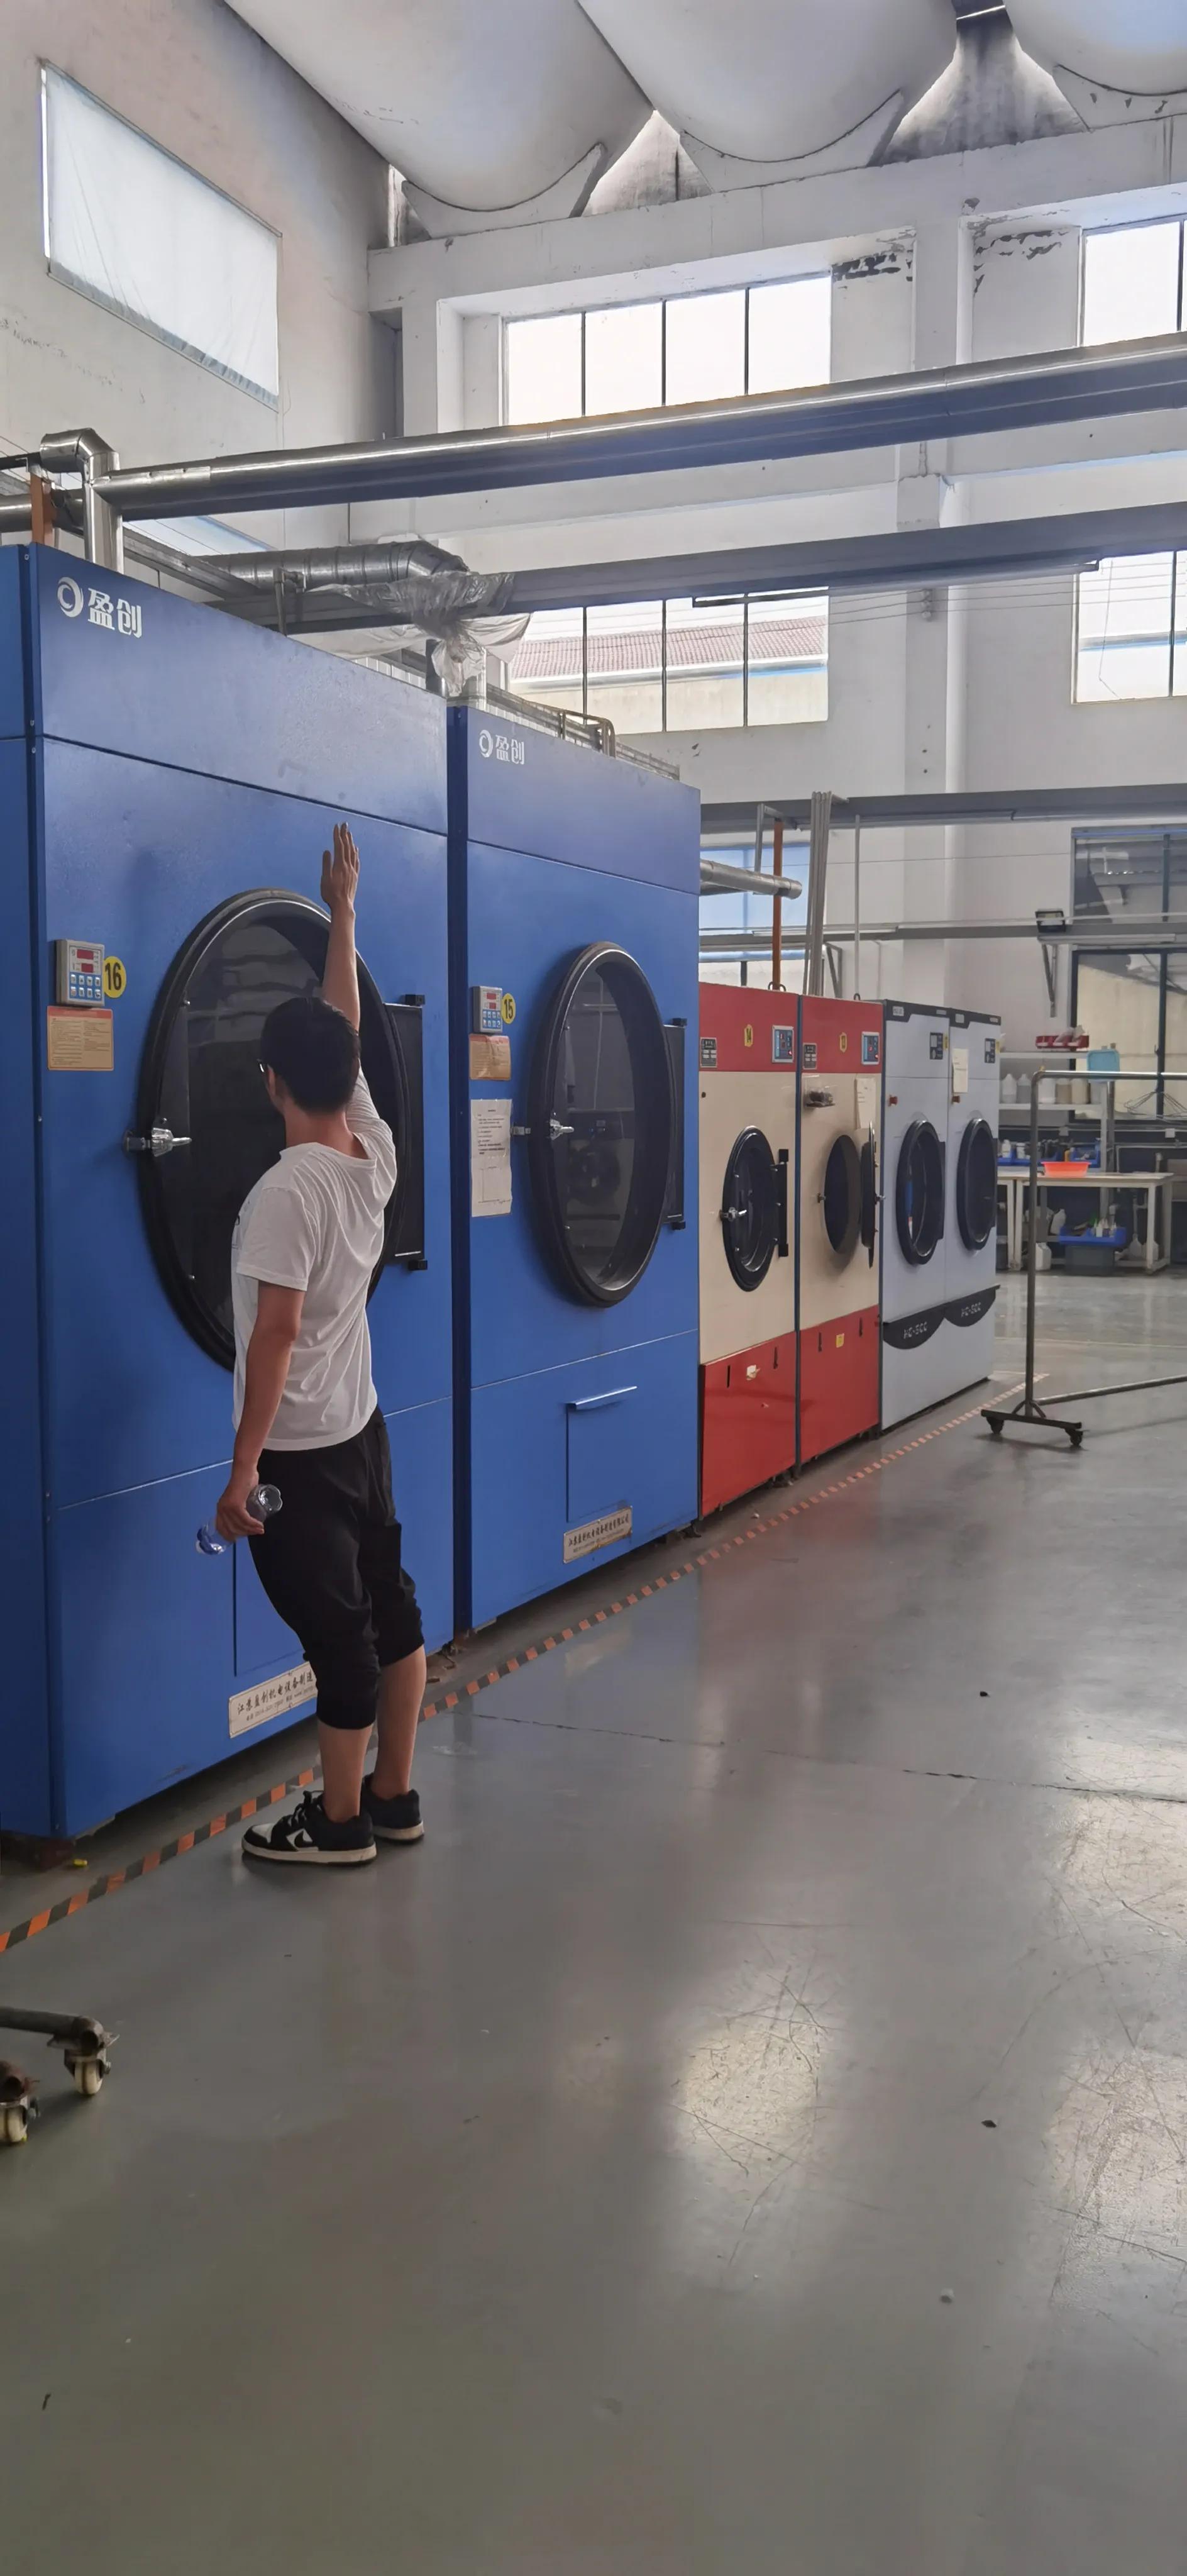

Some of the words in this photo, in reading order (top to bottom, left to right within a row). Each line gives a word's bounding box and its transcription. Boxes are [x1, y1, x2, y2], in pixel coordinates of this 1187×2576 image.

[88, 587, 142, 638] 盈创
[495, 735, 524, 765] 盈创
[104, 962, 123, 991] 16
[504, 999, 514, 1019] 15
